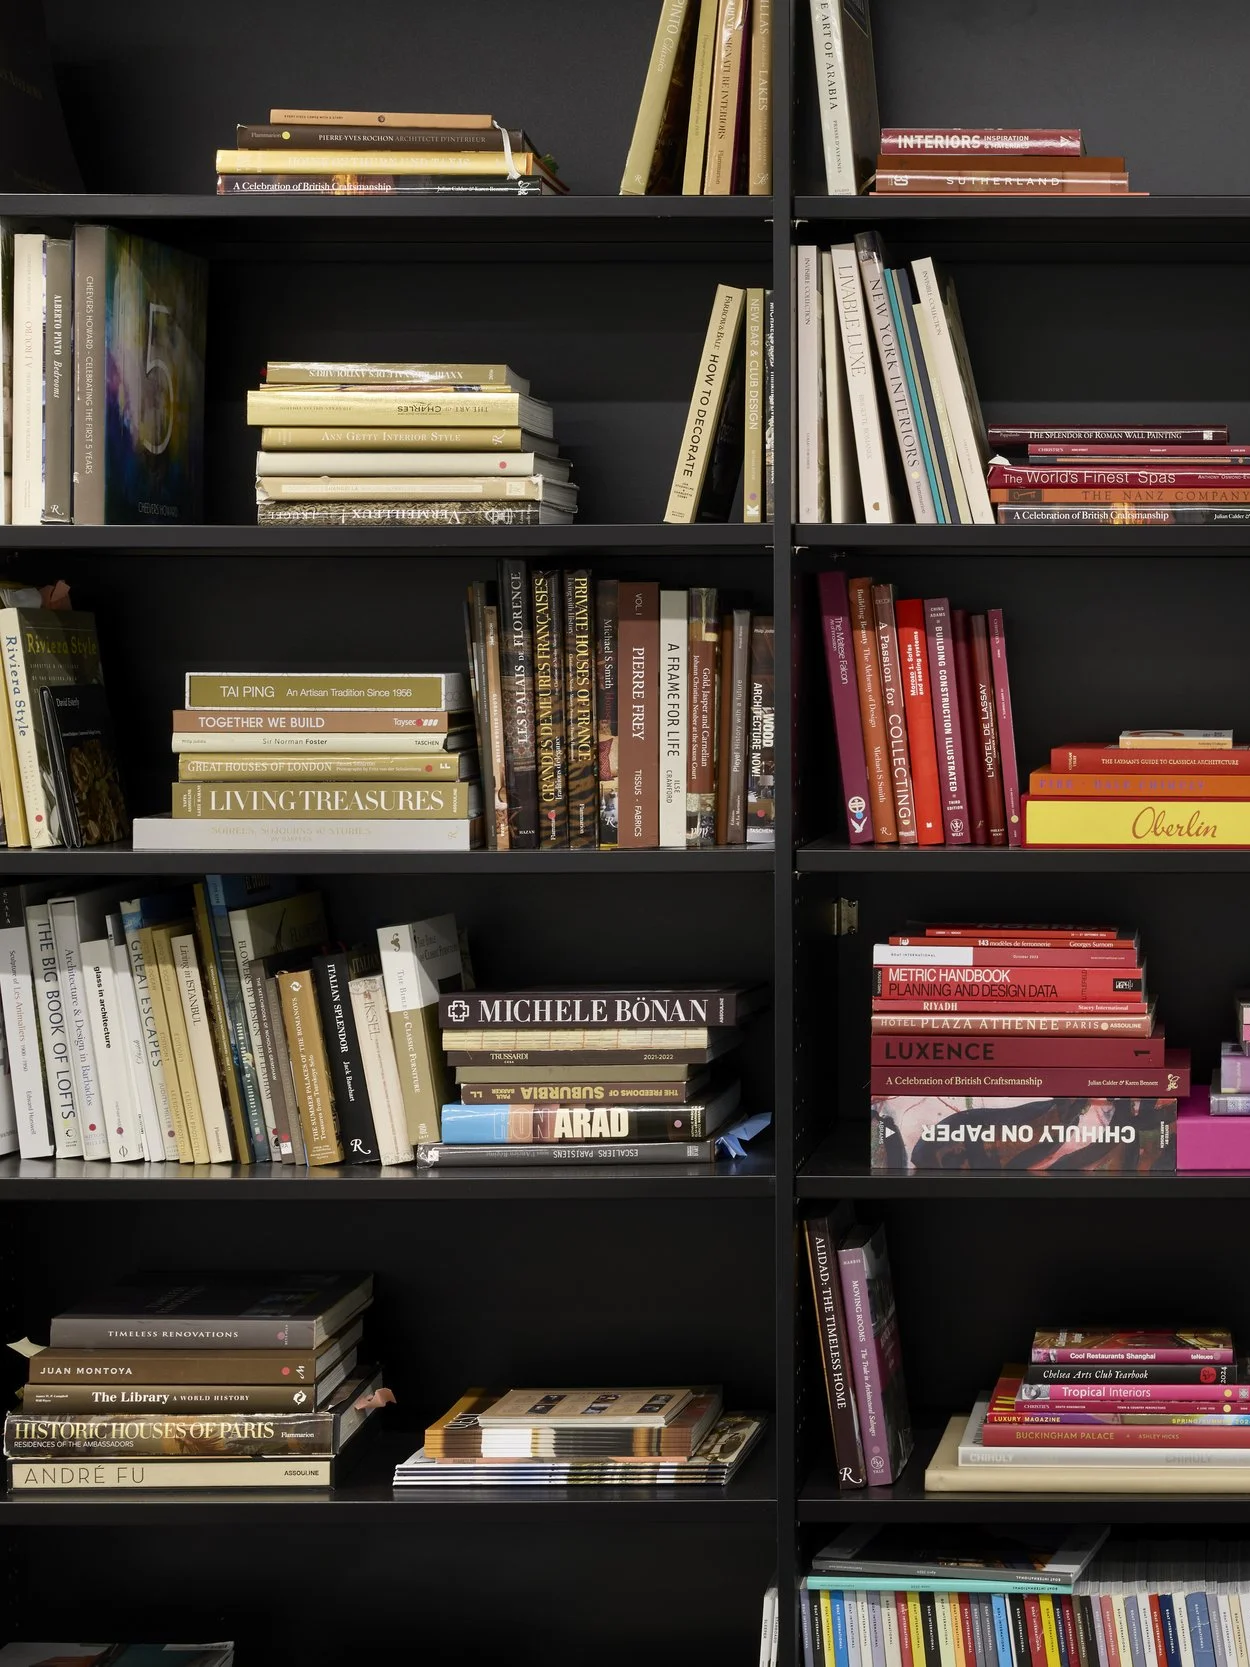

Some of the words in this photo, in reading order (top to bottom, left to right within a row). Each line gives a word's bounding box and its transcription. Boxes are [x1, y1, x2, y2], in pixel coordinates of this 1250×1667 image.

[898, 135, 980, 149] INTERIORS
[233, 182, 240, 190] A
[242, 182, 292, 191] Celebration
[294, 182, 303, 190] of
[303, 182, 330, 191] British
[946, 176, 1060, 186] SUTHERLAND
[838, 265, 858, 332] LIVABLE
[847, 334, 867, 377] LUXE
[53, 360, 63, 398] Bedrooms
[143, 302, 174, 455] 5
[703, 353, 719, 387] HOW
[869, 278, 888, 319] NEW
[880, 323, 899, 371] YORK
[890, 376, 920, 468] INTERIORS
[700, 389, 711, 406] TO
[683, 409, 706, 478] DECORATE
[1003, 474, 1023, 484] The
[1084, 471, 1129, 484] Finest
[1138, 471, 1176, 485] Spas
[879, 621, 887, 630] A
[668, 643, 679, 651] A
[935, 626, 946, 666] BUILDING
[880, 635, 891, 683] Passion
[632, 647, 645, 707] PIERRE
[668, 656, 679, 703] FRAME
[220, 685, 239, 697] TAI
[243, 685, 274, 698] PING
[286, 688, 297, 697] An
[300, 688, 327, 697] Artisan
[330, 688, 364, 697] Tradition
[367, 688, 389, 697] Since
[392, 688, 412, 697] 1956
[885, 688, 894, 705] for
[939, 670, 952, 737] CONSTRUCTION
[632, 711, 645, 740] FREY
[668, 707, 679, 727] FOR
[667, 731, 679, 757] LIFE
[889, 714, 910, 818] COLLECTING
[946, 738, 957, 792] ILLUSTRATED
[210, 790, 299, 811] LIVING
[302, 790, 444, 811] TREASURES
[1132, 807, 1217, 839] Oberlin
[38, 922, 54, 952] THE
[41, 957, 56, 983] BIG
[889, 968, 936, 981] METRIC
[939, 970, 1010, 982] HANDBOOK
[889, 983, 952, 996] PLANNING
[955, 984, 981, 996] AND
[982, 984, 1028, 997] DESIGN
[1029, 984, 1058, 998] DATA
[46, 988, 66, 1036] BOOK
[478, 1000, 608, 1022] MICHELE
[614, 997, 708, 1022] BÖNAN
[53, 1043, 69, 1064] OF
[885, 1043, 994, 1060] LUXENCE
[55, 1068, 76, 1119] LOFTS
[554, 1108, 629, 1138] ARAD
[921, 1125, 995, 1141] PAPER
[1002, 1125, 1034, 1142] ON
[1038, 1125, 1135, 1143] CHIHULY
[1043, 1370, 1071, 1380] Chelsea
[1073, 1370, 1092, 1380] Arts
[1095, 1370, 1113, 1380] Club
[1114, 1370, 1148, 1380] Yearbook
[93, 1391, 117, 1403] The
[120, 1391, 169, 1404] Library
[1062, 1386, 1106, 1398] Tropical
[1109, 1387, 1151, 1398] Interiors
[15, 1422, 109, 1439] HISTORIC
[111, 1422, 190, 1439] HOUSES
[193, 1422, 217, 1439] OF
[220, 1422, 274, 1439] PARIS
[24, 1465, 105, 1484] ANDRÉ
[117, 1467, 145, 1484] FU
